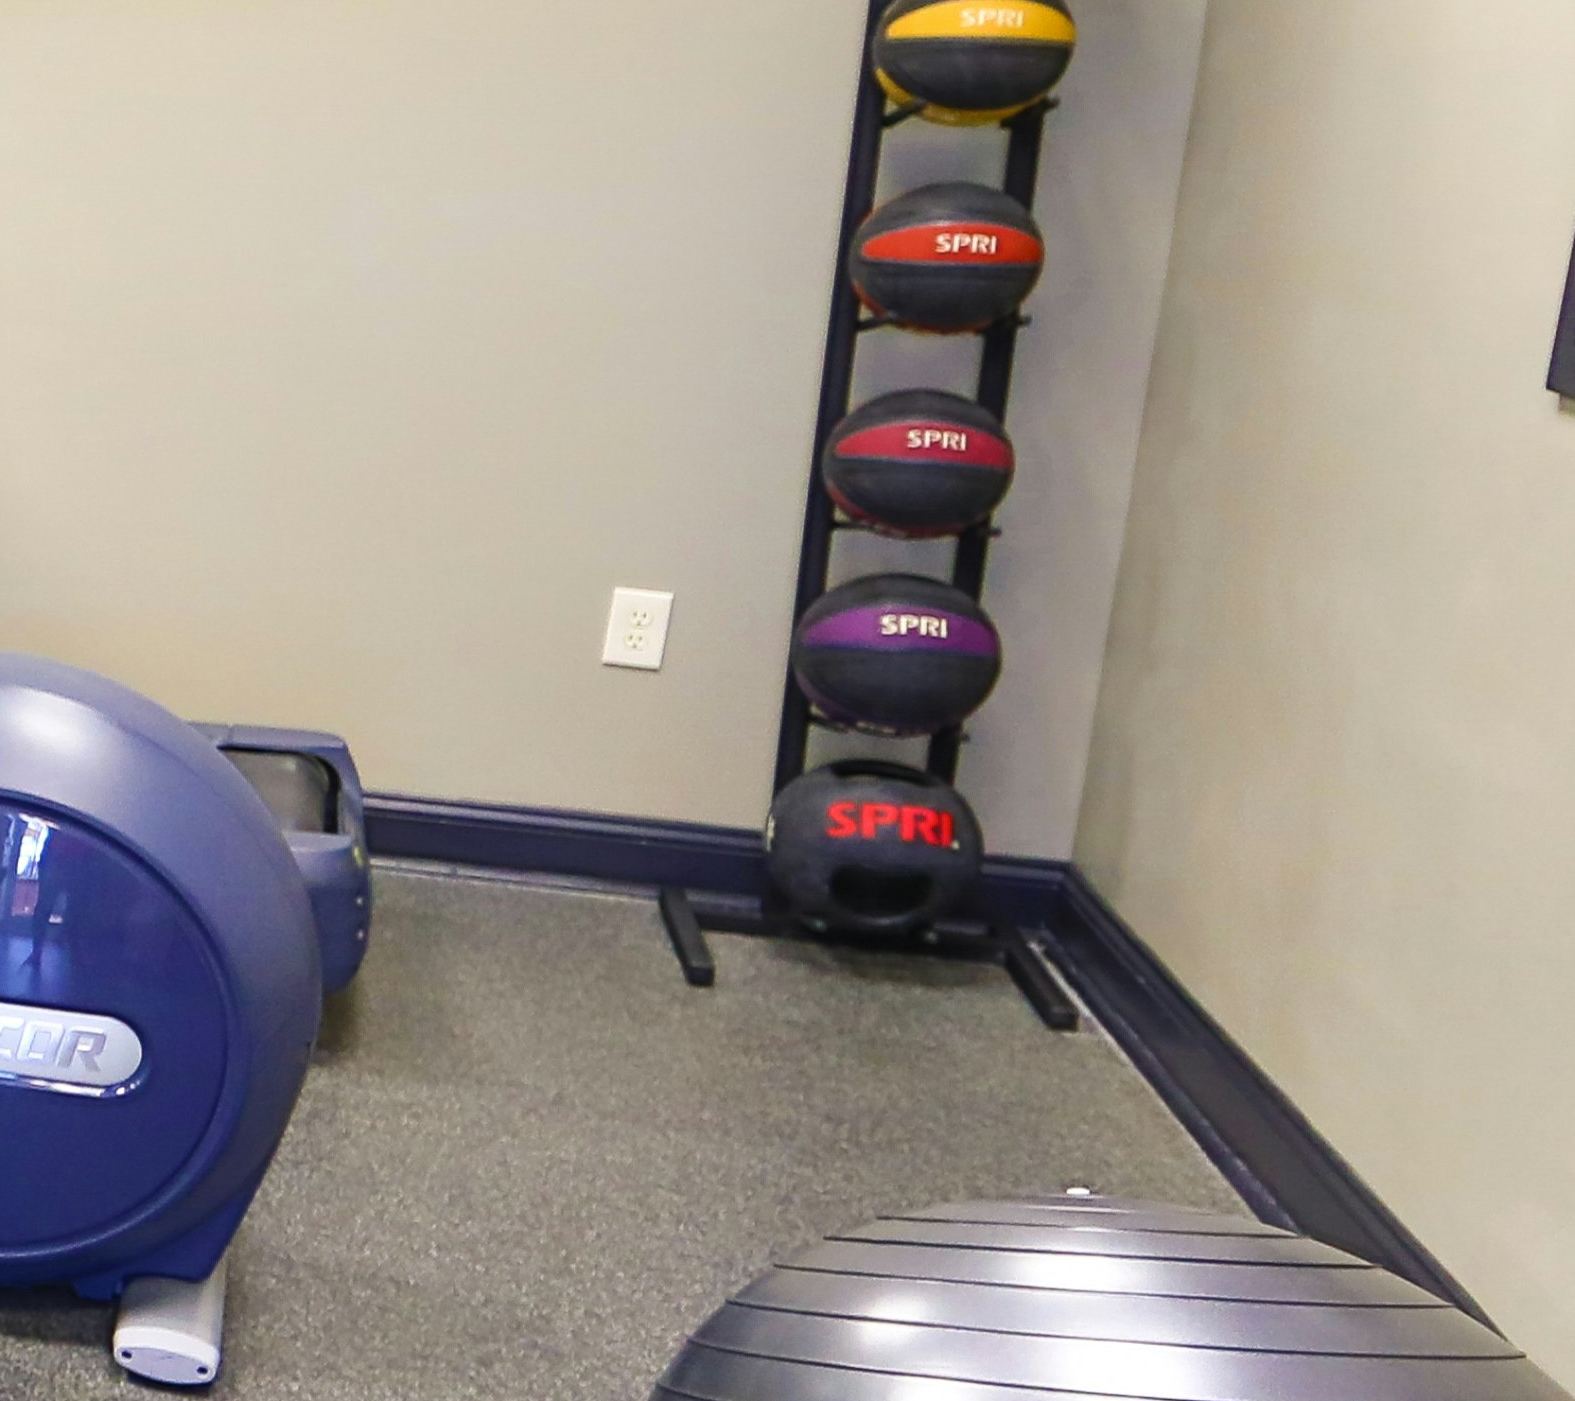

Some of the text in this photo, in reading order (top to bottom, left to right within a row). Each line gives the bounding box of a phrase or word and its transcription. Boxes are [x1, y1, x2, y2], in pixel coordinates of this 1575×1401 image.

[960, 9, 1024, 28] SPRI
[935, 232, 998, 254] SPRI
[907, 429, 967, 452] SPRI
[881, 613, 947, 638] SPRI
[826, 801, 954, 847] SPRI
